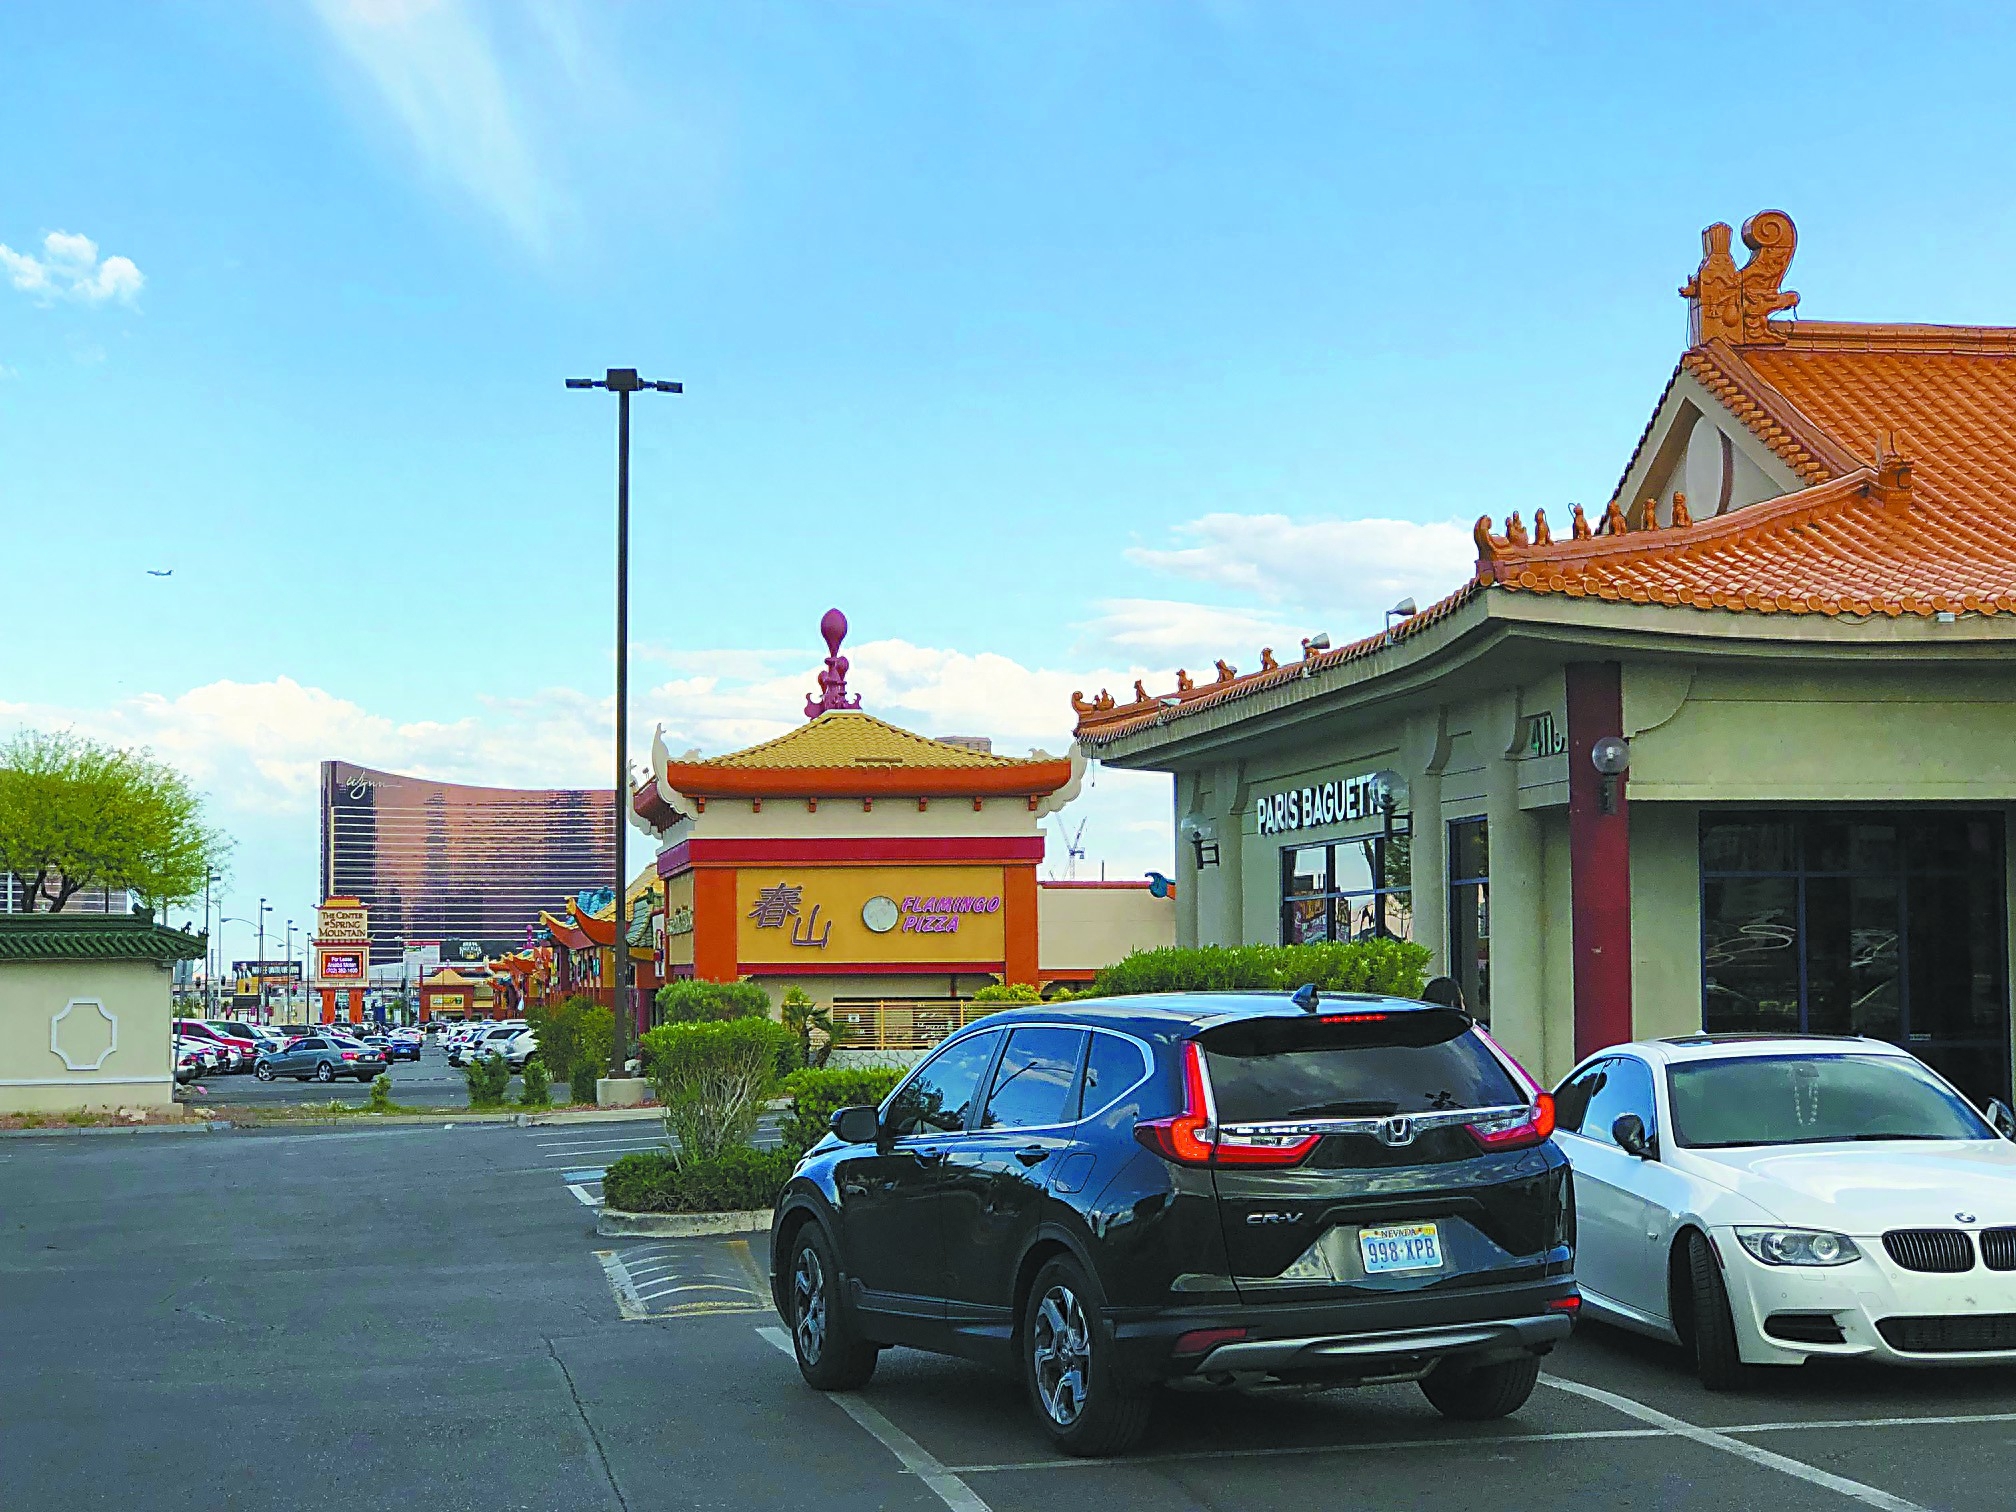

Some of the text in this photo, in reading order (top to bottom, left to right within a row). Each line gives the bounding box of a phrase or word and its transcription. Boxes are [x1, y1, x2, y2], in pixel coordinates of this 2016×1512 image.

[1257, 790, 1299, 834] PARIS
[901, 896, 1001, 914] FLAMINGO
[336, 911, 364, 920] CENTER
[329, 920, 361, 929] SPRING
[902, 915, 960, 933] PIZZA
[318, 928, 366, 938] MOUNTAIN
[1246, 1212, 1304, 1225] CR-V
[1381, 1228, 1418, 1239] NEVADA
